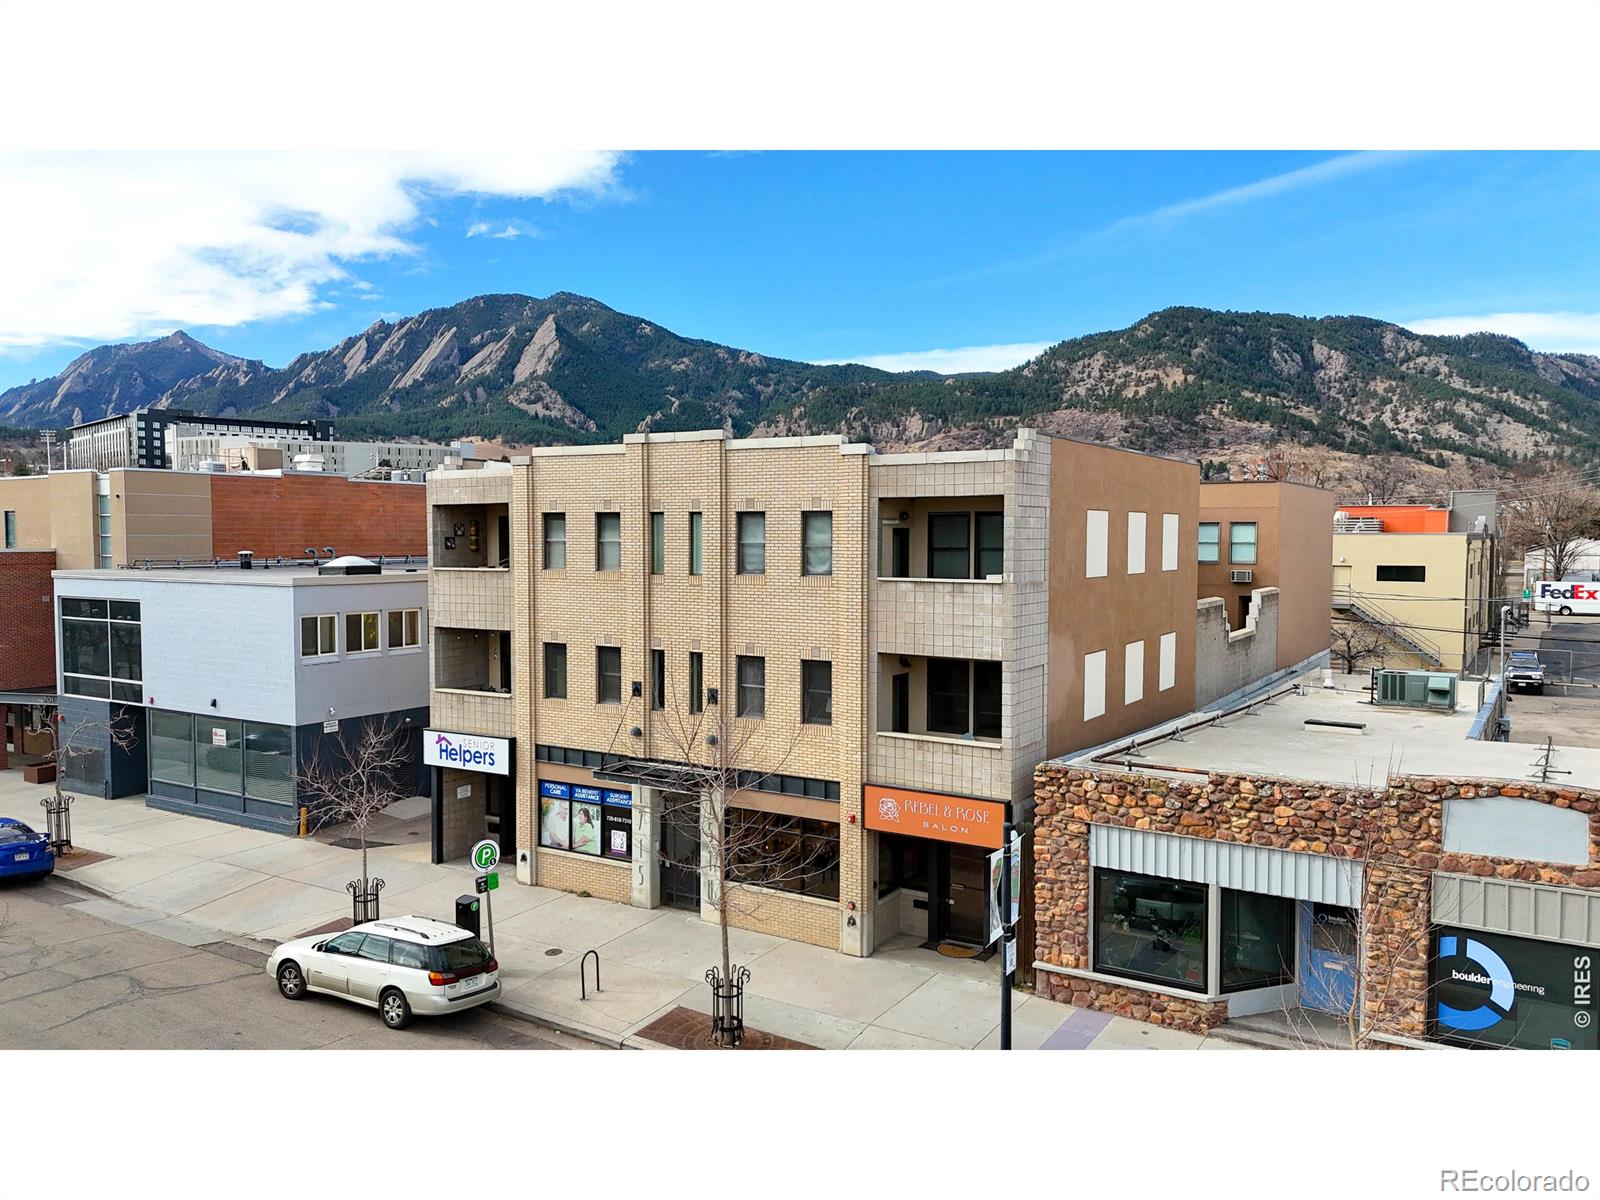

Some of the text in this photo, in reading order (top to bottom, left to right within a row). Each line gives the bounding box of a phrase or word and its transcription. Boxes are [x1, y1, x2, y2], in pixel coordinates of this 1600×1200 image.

[1540, 584, 1599, 600] FedEx
[463, 738, 495, 751] SENIOR
[439, 743, 495, 767] Helpers
[574, 792, 600, 801] ASSISTANCE
[904, 799, 990, 824] REBEL & ROSE
[923, 821, 969, 834] SALON
[481, 848, 492, 864] P
